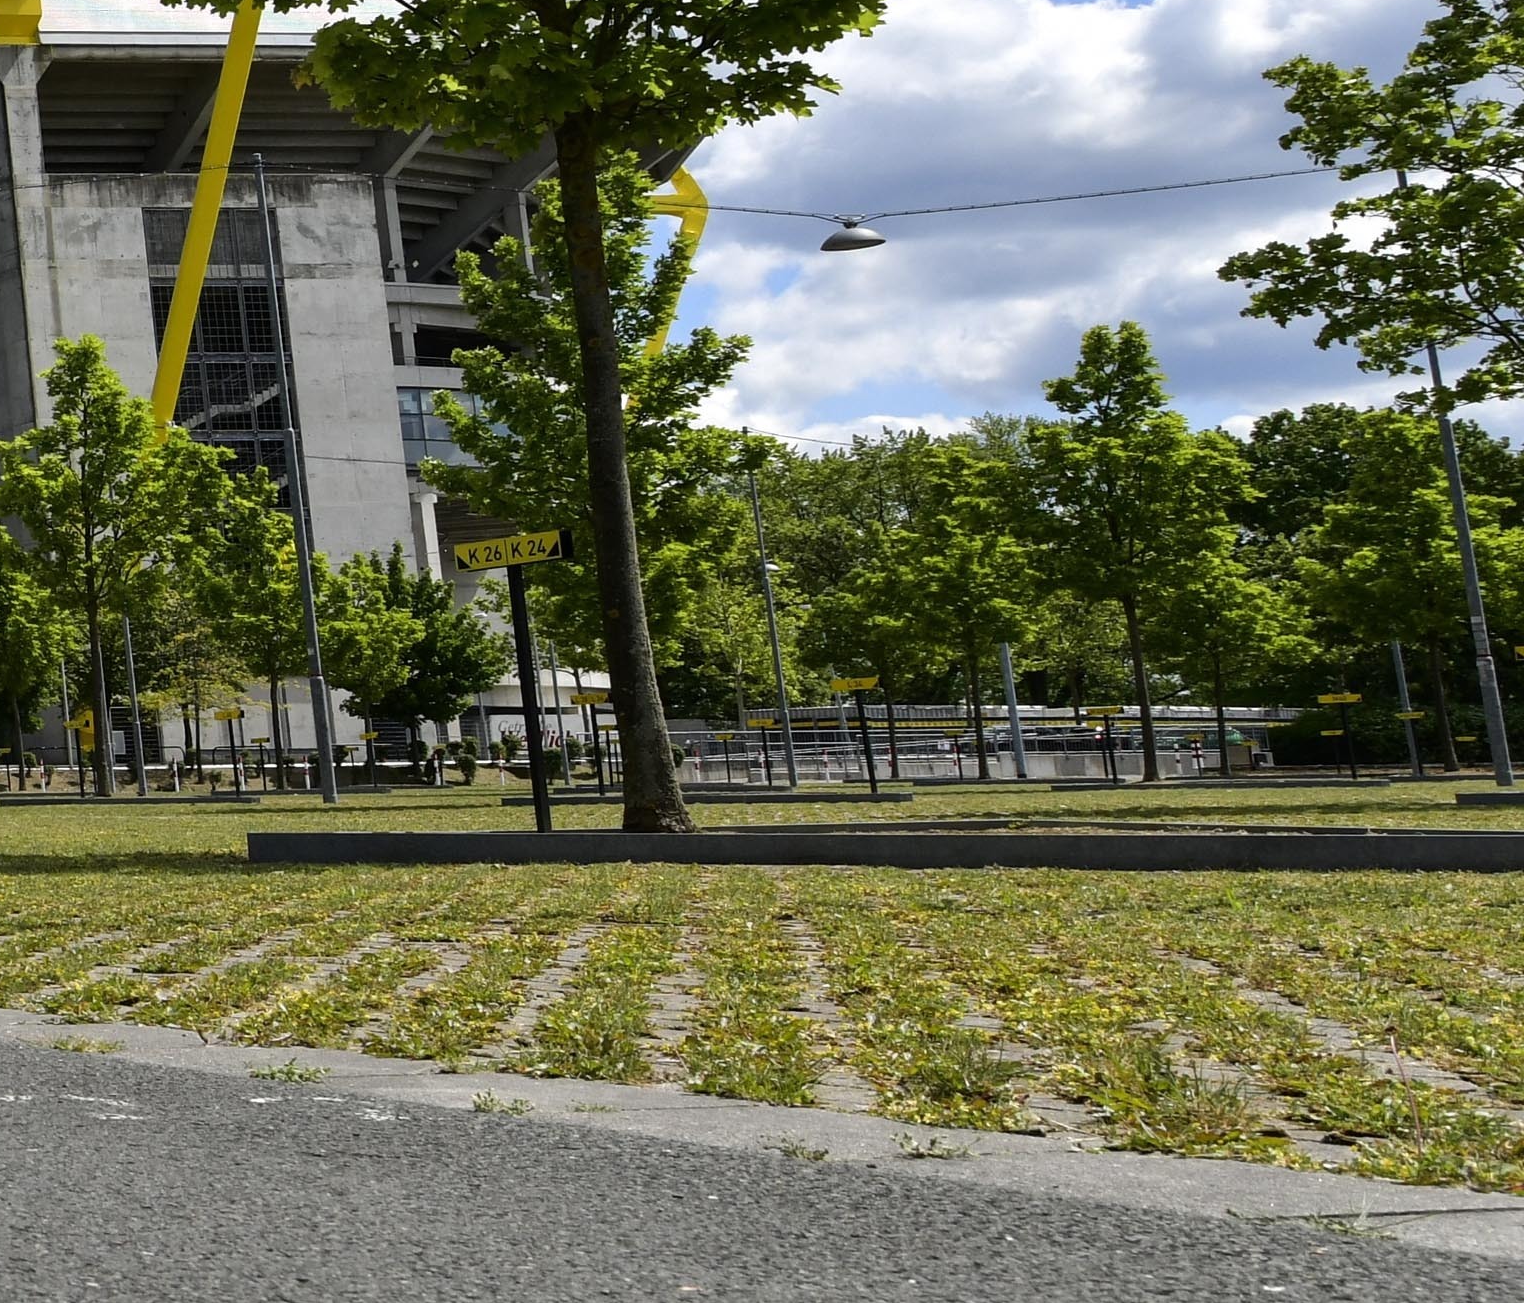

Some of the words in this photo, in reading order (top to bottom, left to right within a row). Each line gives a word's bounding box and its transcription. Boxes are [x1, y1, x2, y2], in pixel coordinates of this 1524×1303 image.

[468, 548, 480, 564] K
[483, 545, 502, 563] 26
[510, 541, 523, 558] K
[527, 538, 546, 556] 24
